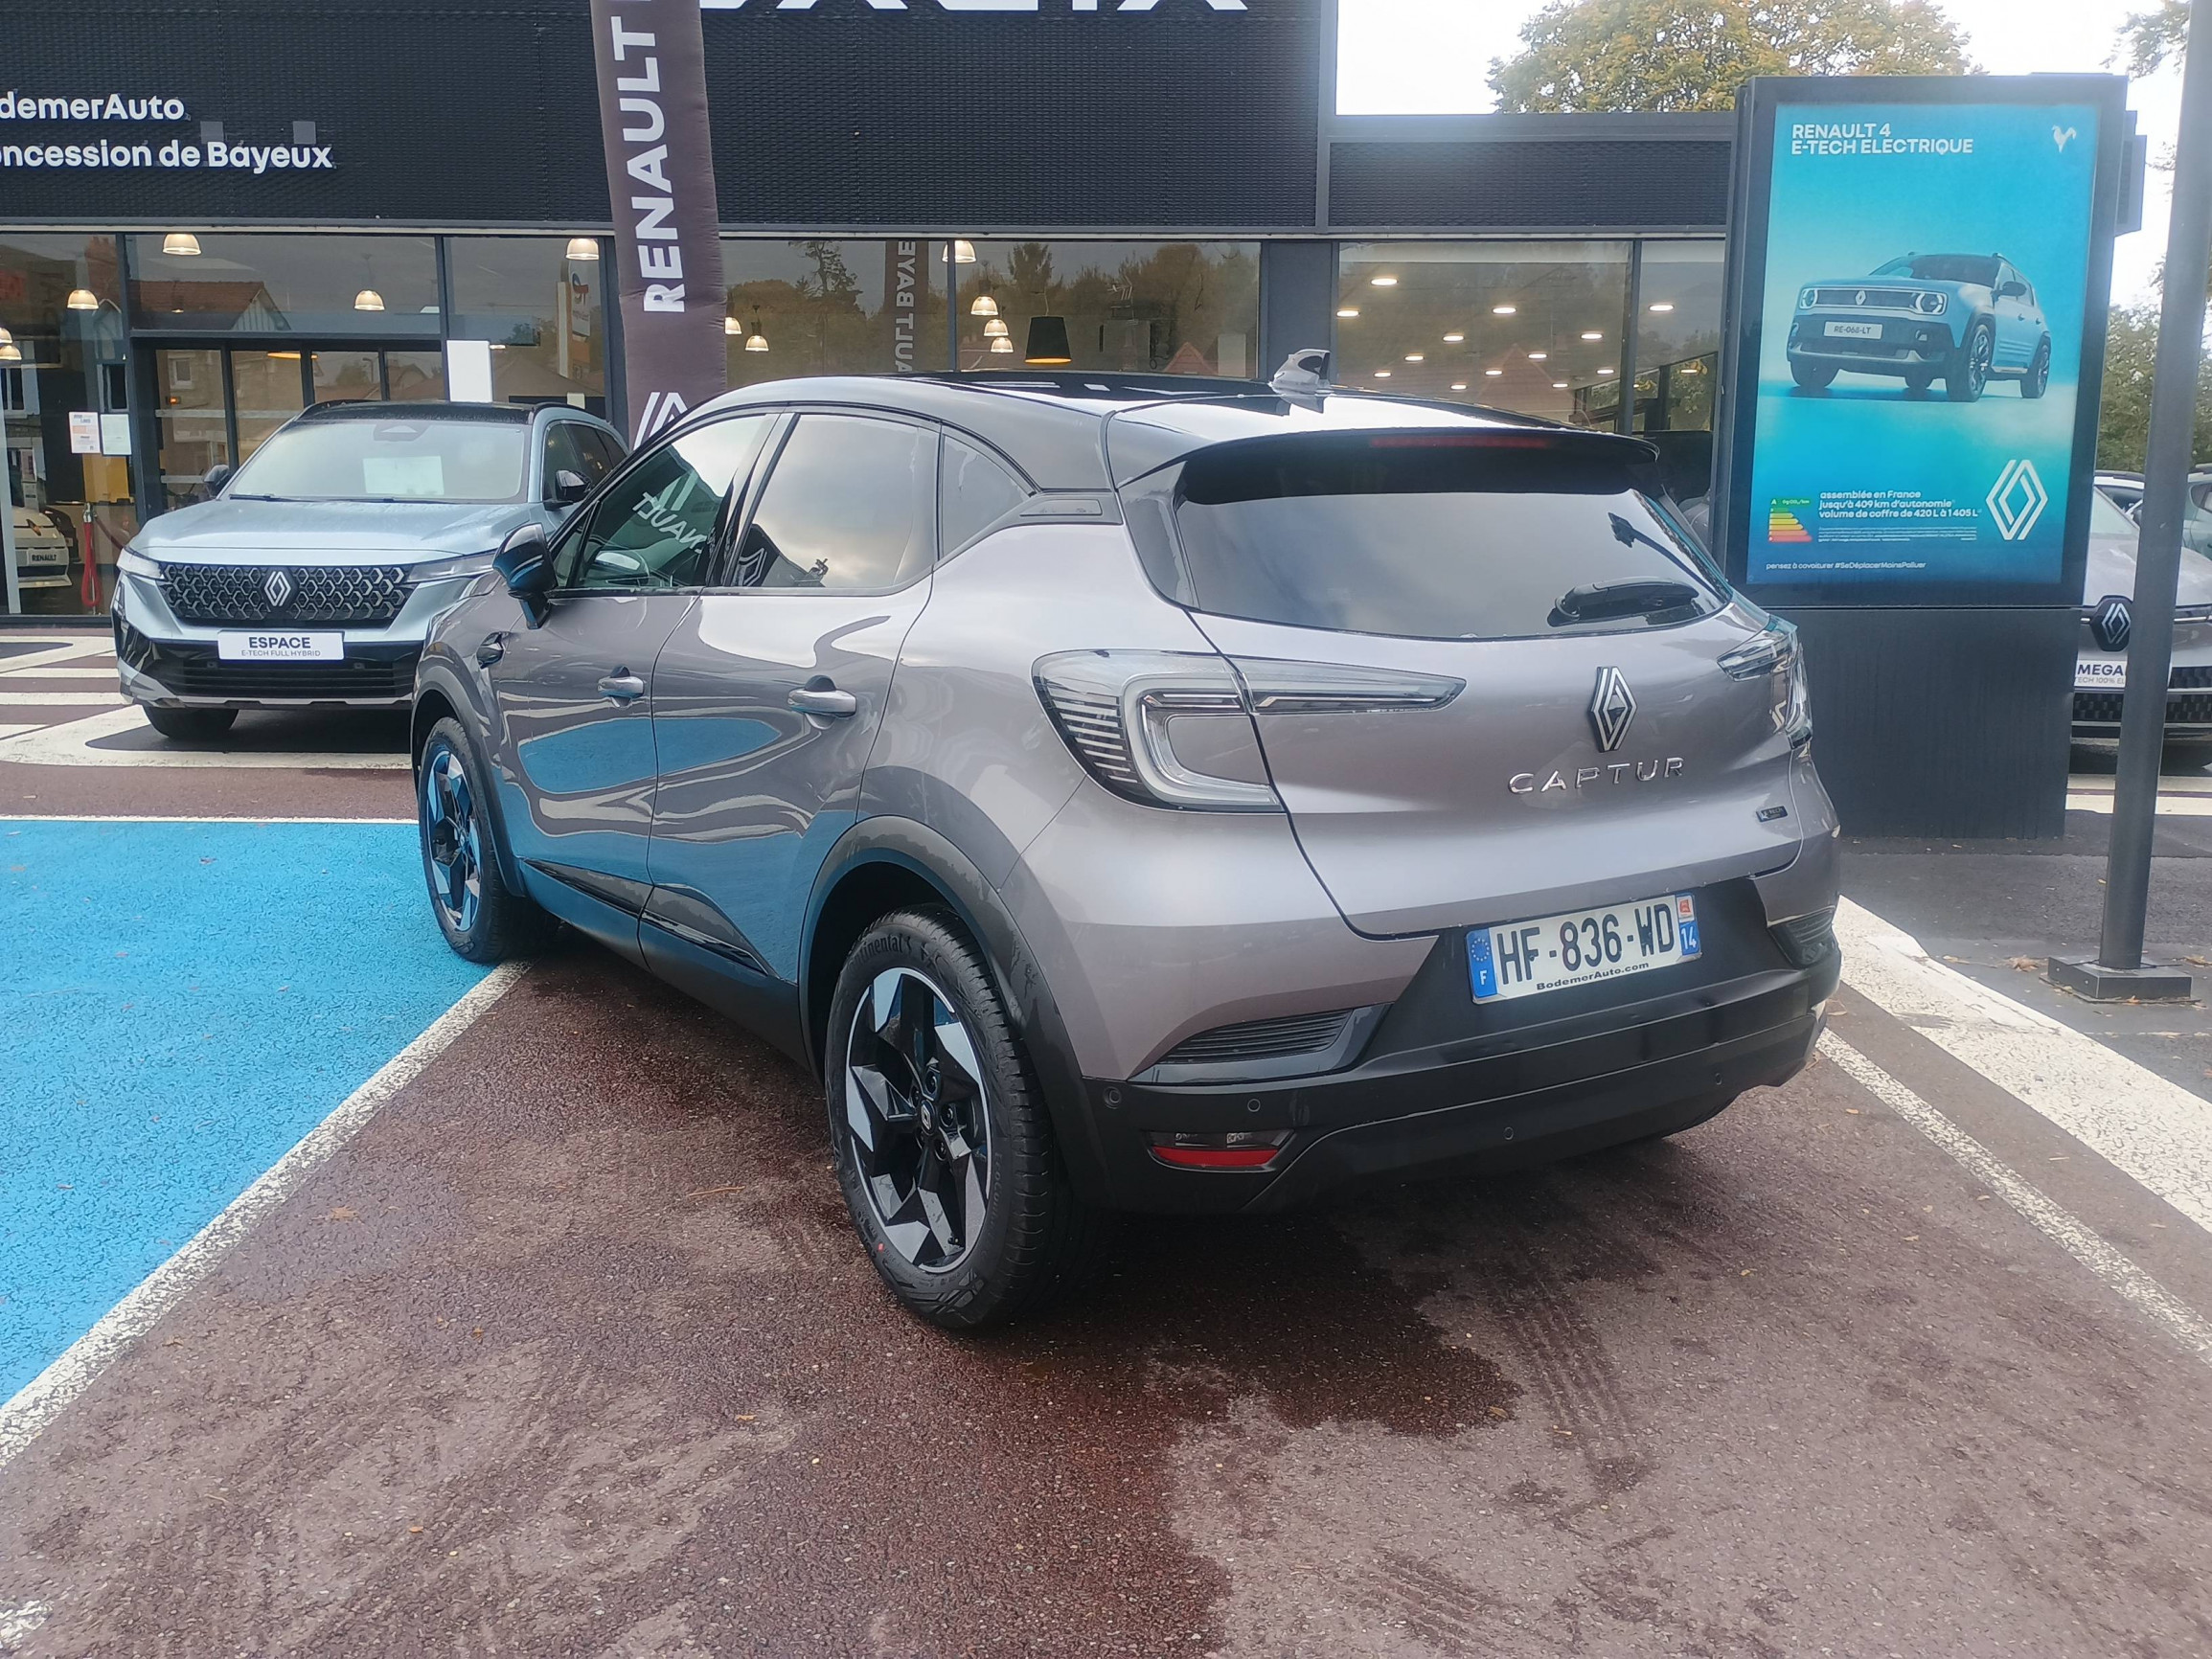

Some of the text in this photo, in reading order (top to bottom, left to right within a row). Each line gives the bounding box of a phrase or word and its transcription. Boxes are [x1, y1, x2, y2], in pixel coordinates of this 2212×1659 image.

[1792, 123, 1891, 139] RENAULT 4
[1791, 139, 1973, 155] E-TECH ELECTRIQUE
[0, 140, 333, 174] ncession de Bayeux
[610, 15, 686, 313] RENAULT
[1887, 489, 1922, 499] France
[1855, 500, 1874, 509] 409
[1874, 499, 1890, 509] km
[1819, 509, 1855, 518] volume
[1855, 509, 1868, 518] de
[1869, 509, 1900, 518] coffre
[1900, 509, 1913, 518] de
[1913, 509, 1932, 517] 420
[32, 554, 57, 562] RENAULT
[248, 637, 311, 648] ESPACE
[1507, 757, 1684, 794] CAPTUR
[1496, 903, 1697, 985] HF-836-WD 14
[1480, 969, 1487, 986] F
[1536, 960, 1650, 991] BodemerAuto.com
